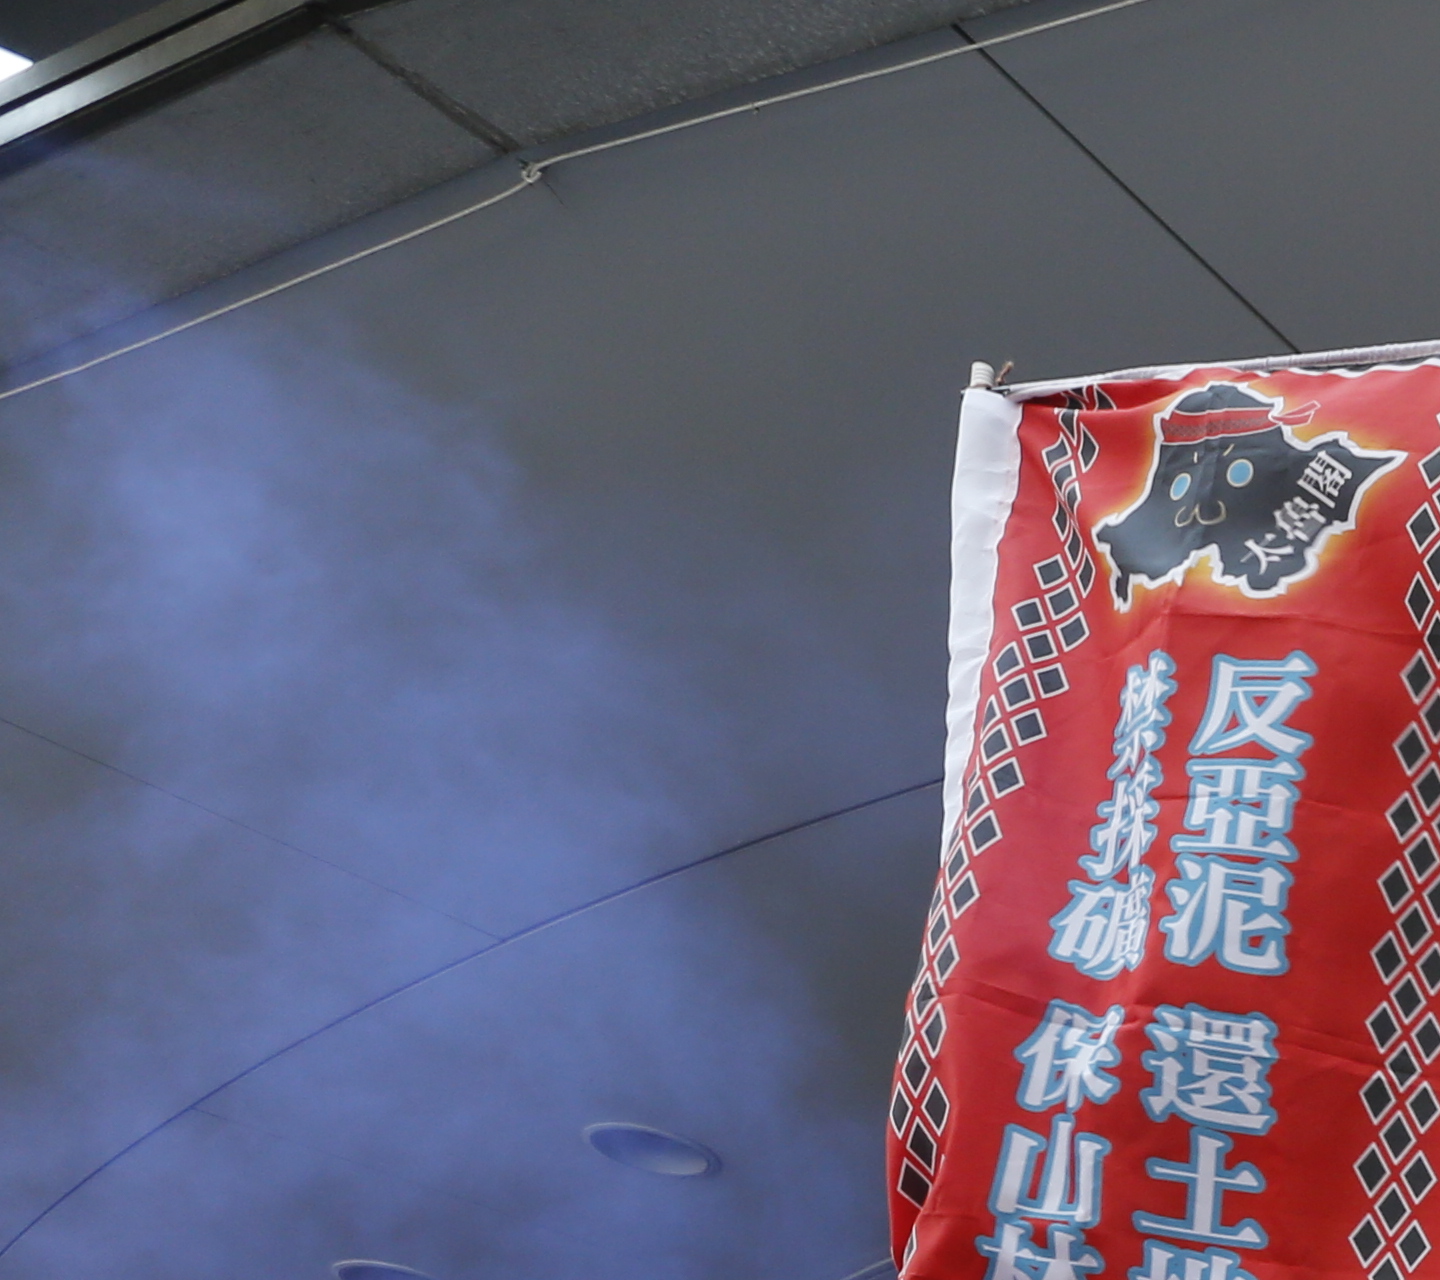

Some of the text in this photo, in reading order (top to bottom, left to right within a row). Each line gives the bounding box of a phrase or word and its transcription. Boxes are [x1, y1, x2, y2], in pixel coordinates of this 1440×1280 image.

[1241, 450, 1353, 575] 太魯閣
[1048, 649, 1178, 980] 禁採礦
[1158, 650, 1318, 975] 反亞泥
